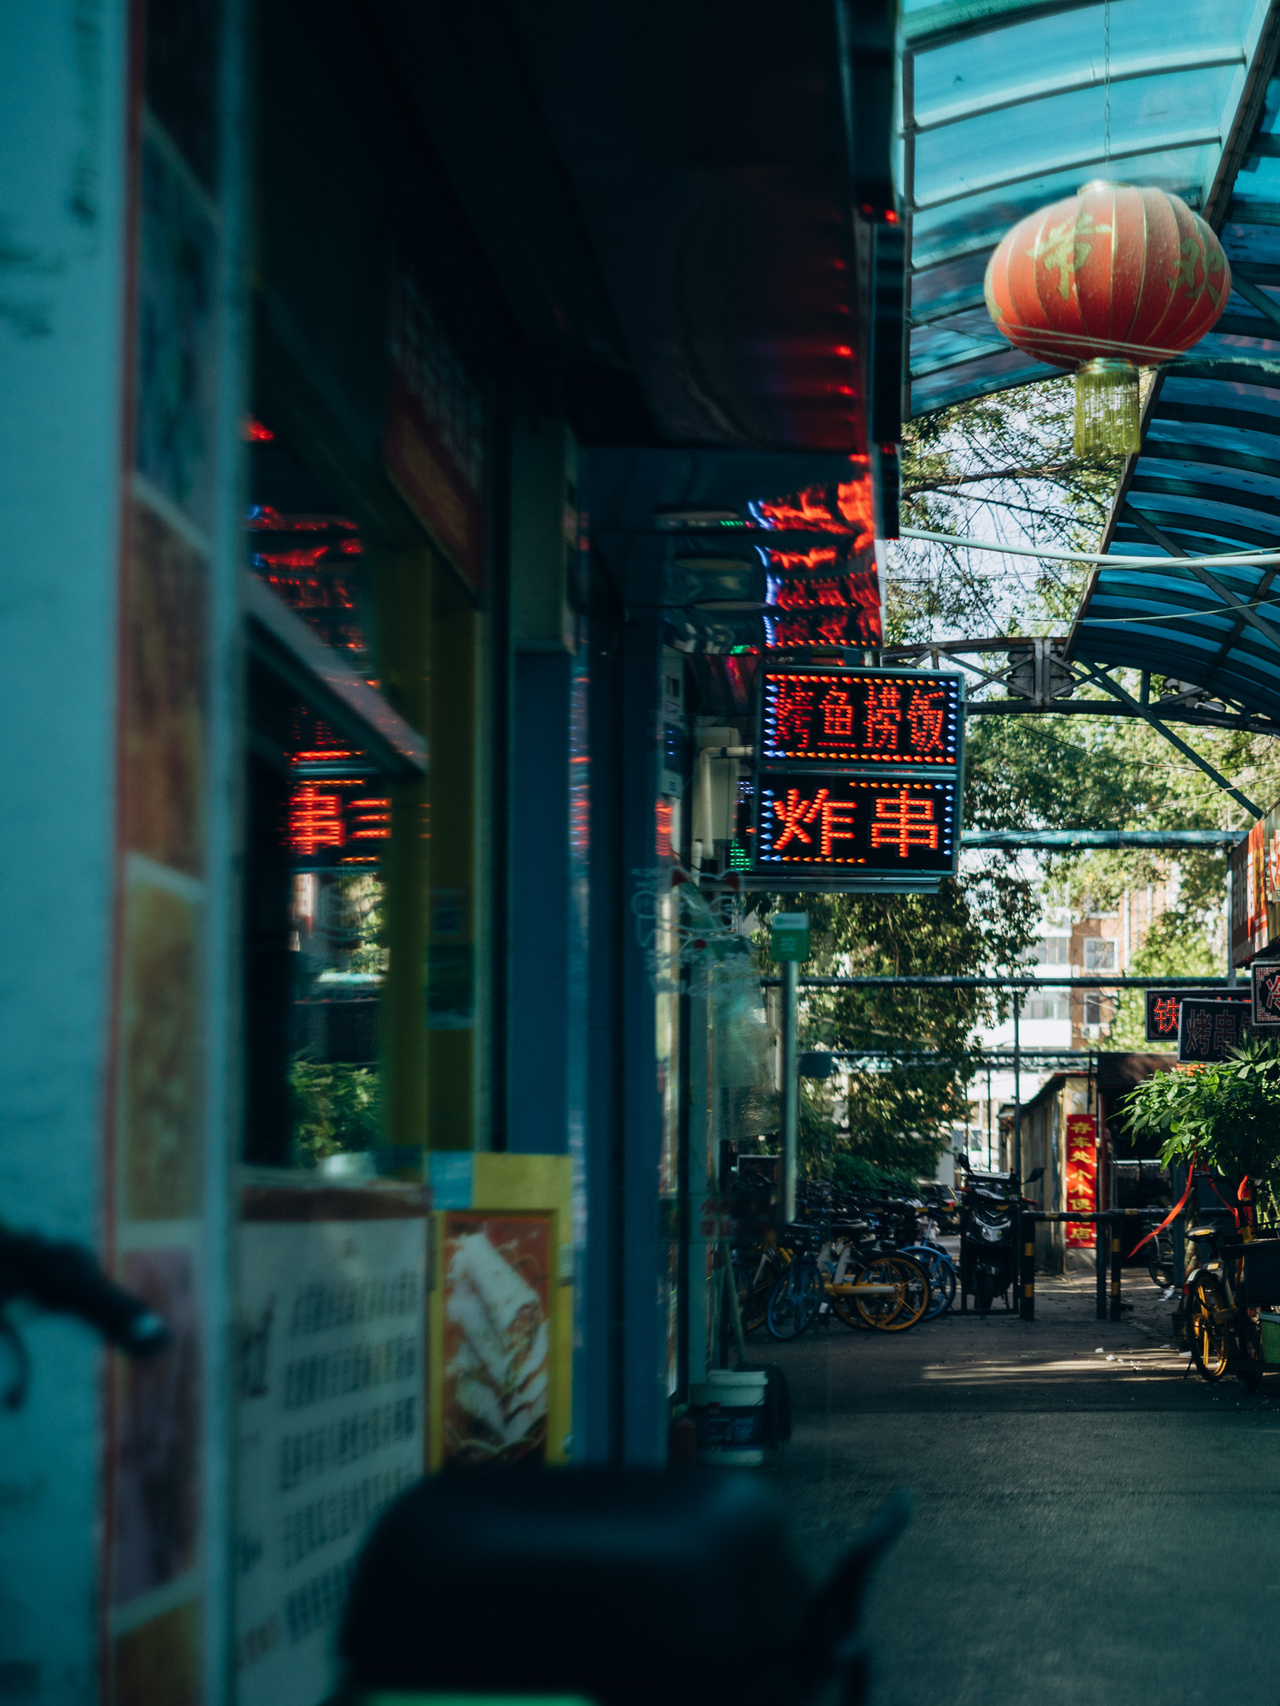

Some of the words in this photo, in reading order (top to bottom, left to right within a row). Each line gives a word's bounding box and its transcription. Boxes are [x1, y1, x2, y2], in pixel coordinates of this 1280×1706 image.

[773, 683, 946, 752] 烤鱼捞饭
[772, 788, 938, 858] 炸串
